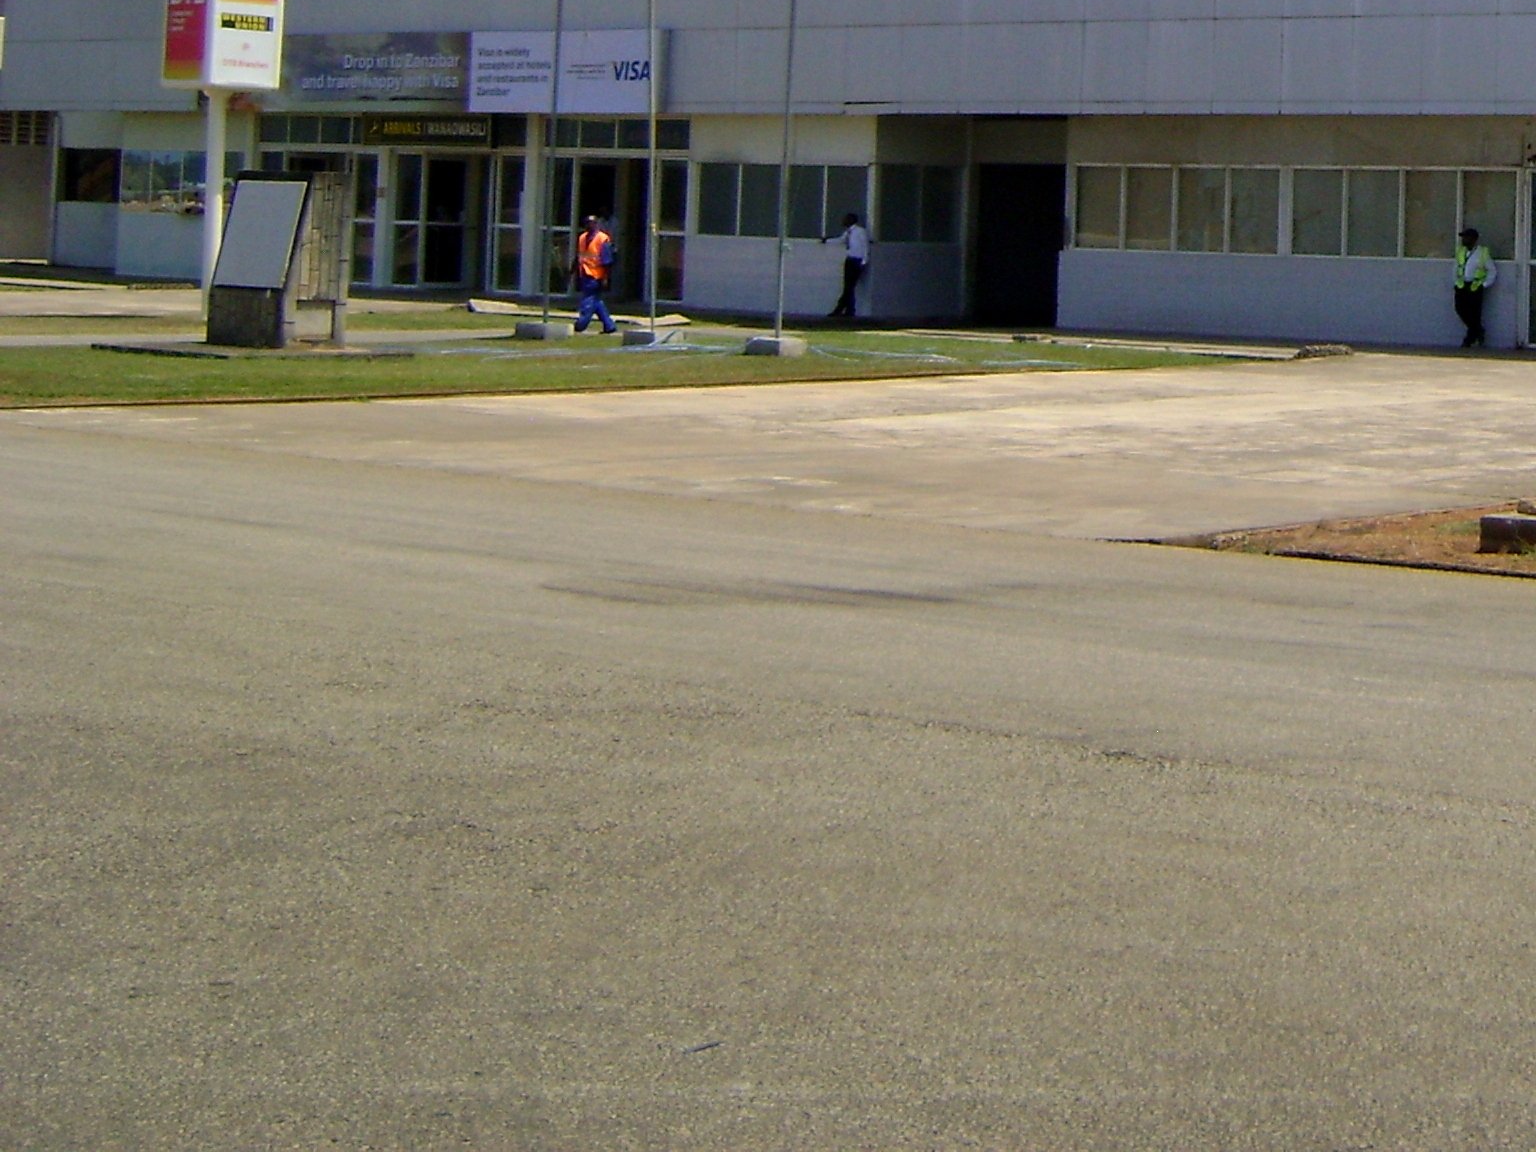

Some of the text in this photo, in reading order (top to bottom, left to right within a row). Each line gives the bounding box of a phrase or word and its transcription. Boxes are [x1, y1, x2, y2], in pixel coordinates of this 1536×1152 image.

[222, 13, 267, 24] WESTERN
[235, 21, 266, 30] UNION
[344, 54, 376, 70] Drop
[405, 52, 460, 69] Zanzibar
[613, 61, 651, 81] VISA
[302, 74, 460, 91] and travel happy with Visa
[383, 121, 421, 135] ARRIVALS
